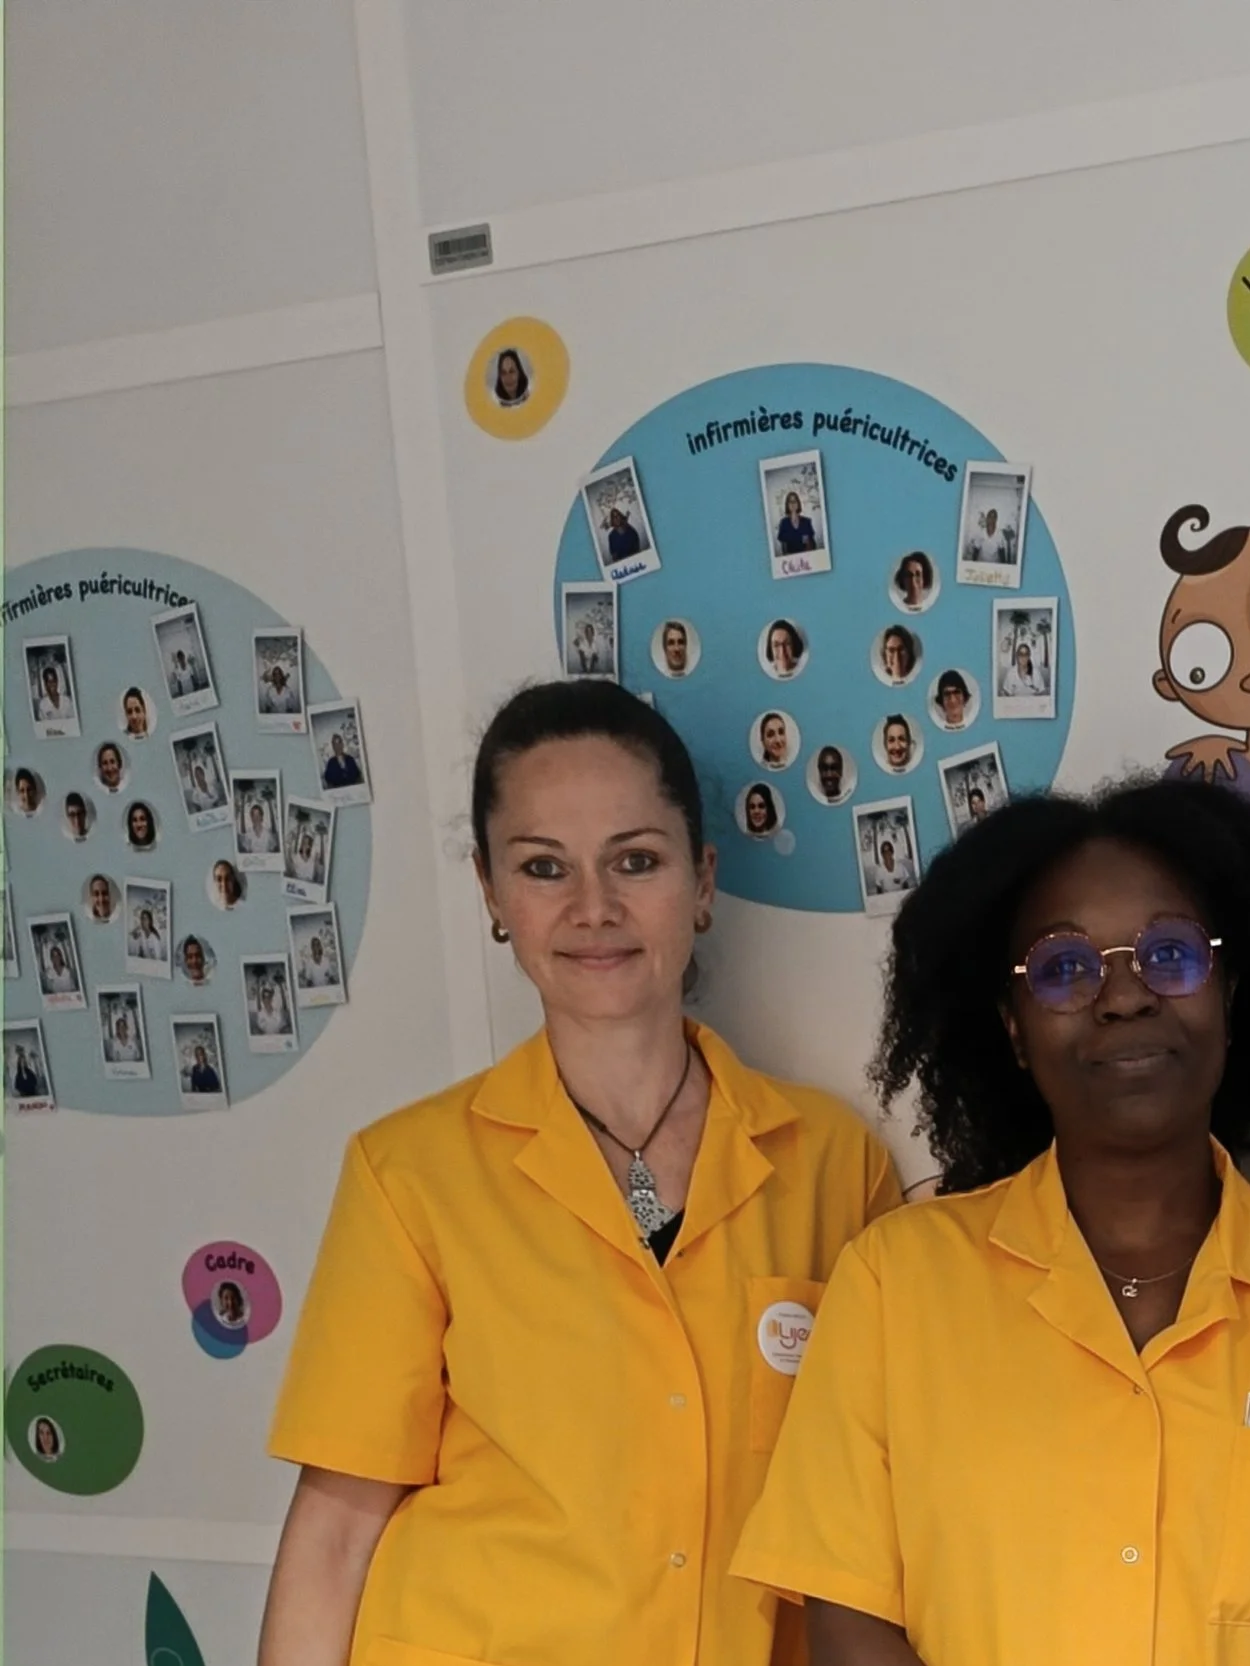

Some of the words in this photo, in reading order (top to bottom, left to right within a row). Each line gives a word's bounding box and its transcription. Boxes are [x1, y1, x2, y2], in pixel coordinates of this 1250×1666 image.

[686, 406, 804, 456] infirmières
[812, 407, 959, 483] puéricultrices
[79, 571, 196, 608] puéricultrice
[204, 1251, 256, 1275] Cadre
[27, 1360, 115, 1394] Secrétaires
